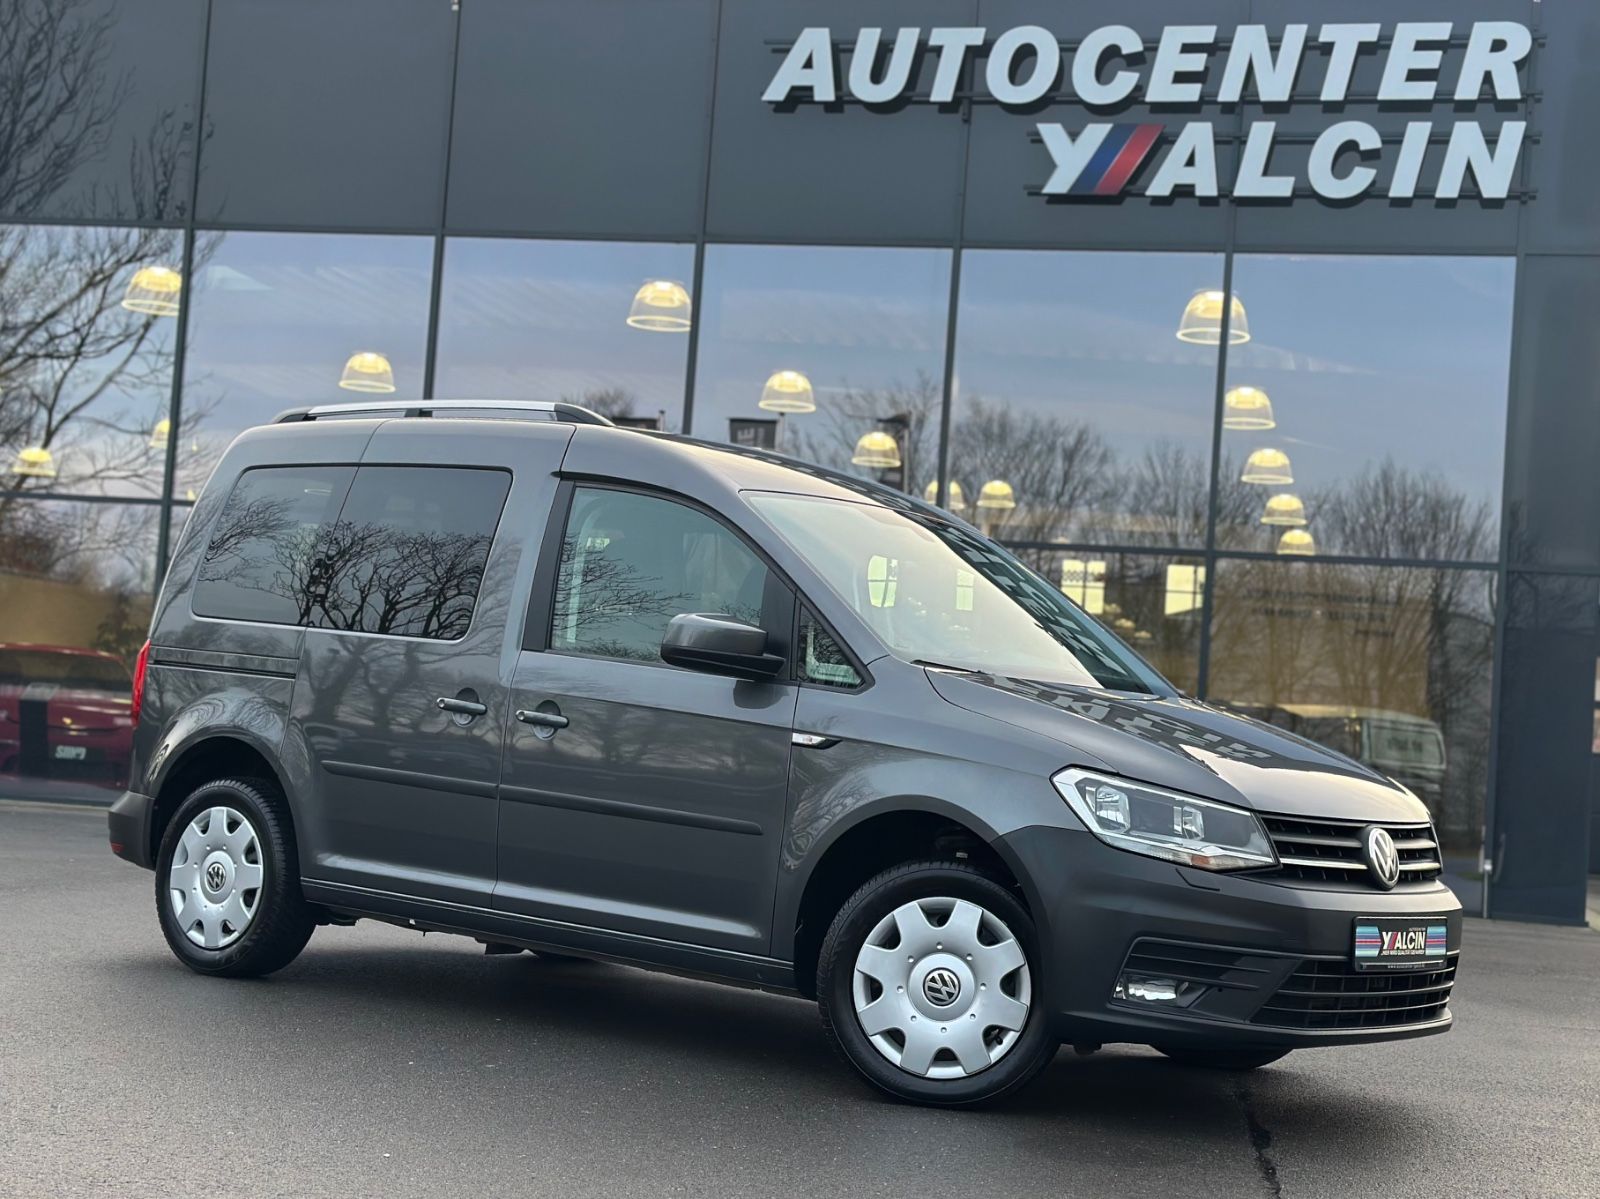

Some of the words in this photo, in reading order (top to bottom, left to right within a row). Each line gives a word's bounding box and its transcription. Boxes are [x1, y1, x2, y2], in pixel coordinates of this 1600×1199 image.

[762, 21, 1532, 104] AUTOCENTER
[1036, 121, 1527, 199] YALCIN
[1382, 931, 1426, 950] YALCIN
